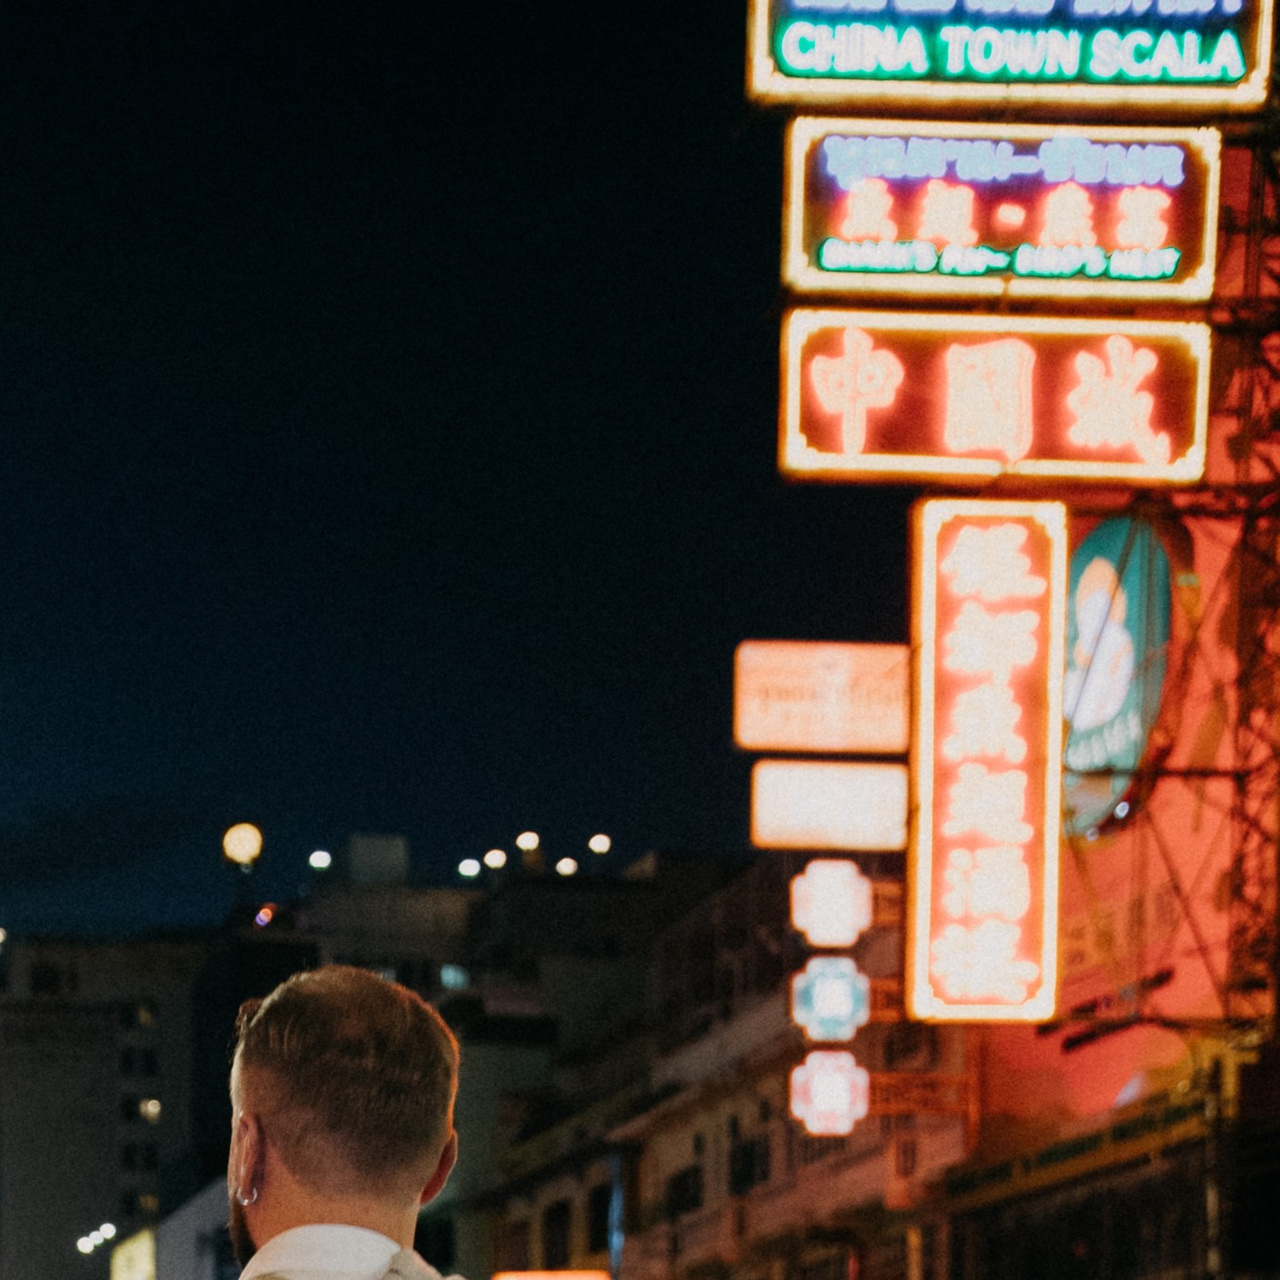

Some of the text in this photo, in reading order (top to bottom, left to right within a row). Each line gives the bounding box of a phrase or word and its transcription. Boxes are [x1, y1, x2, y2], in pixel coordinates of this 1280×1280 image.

[780, 22, 1246, 80] CHINA TOWN SCALA
